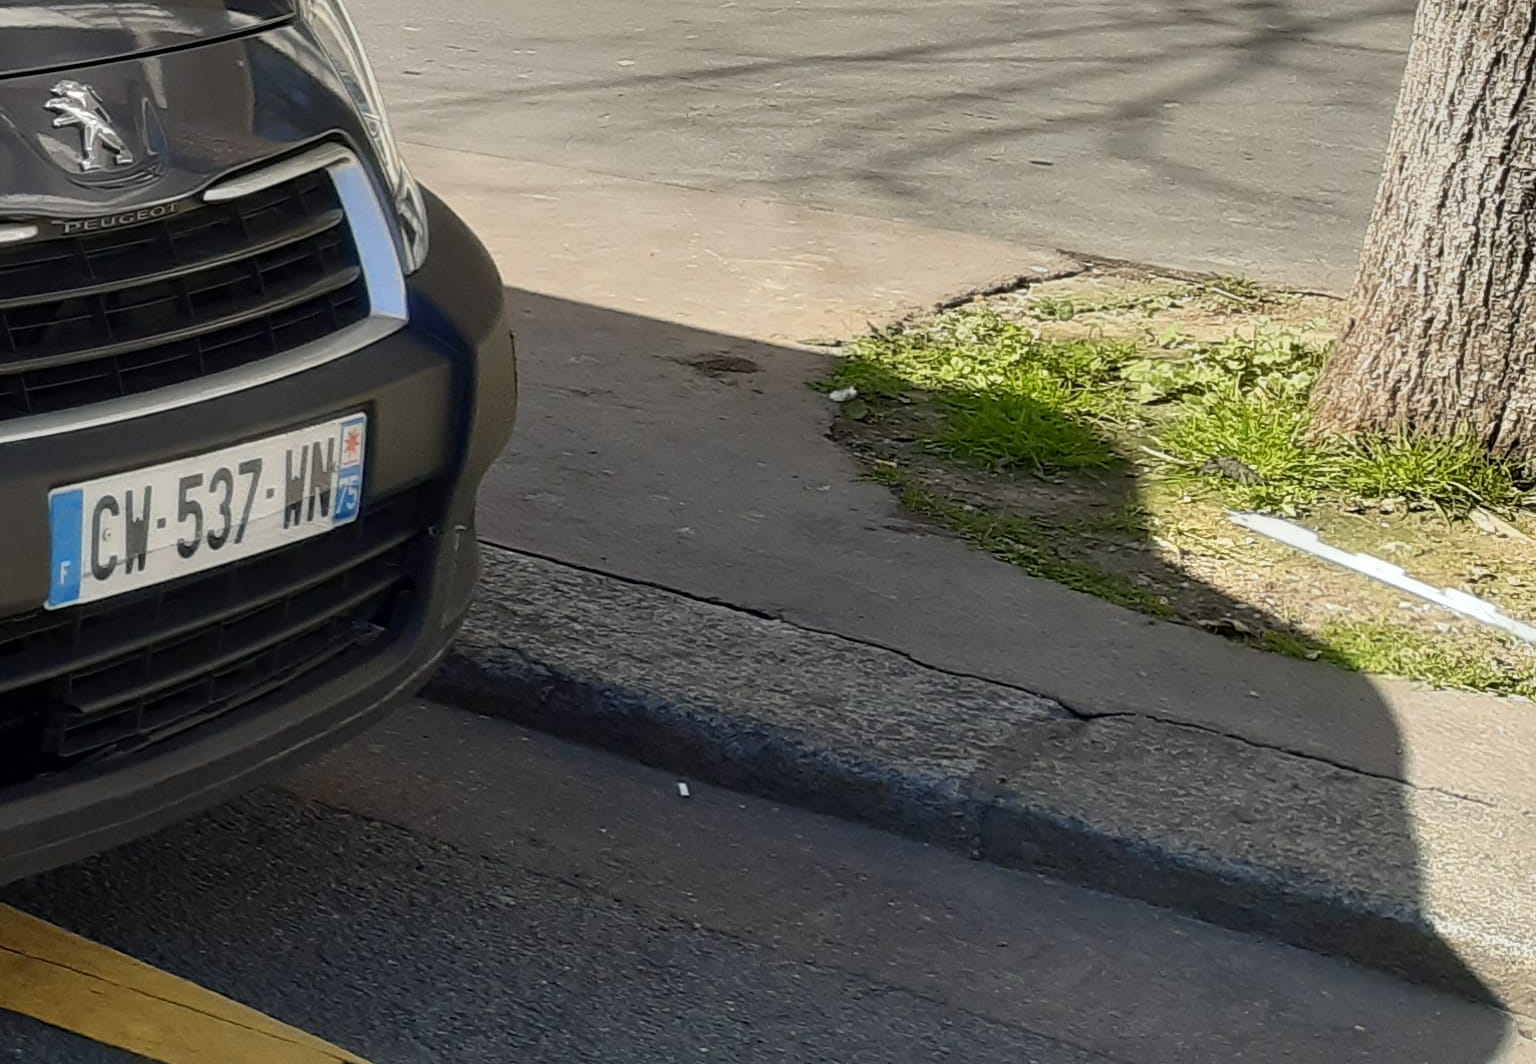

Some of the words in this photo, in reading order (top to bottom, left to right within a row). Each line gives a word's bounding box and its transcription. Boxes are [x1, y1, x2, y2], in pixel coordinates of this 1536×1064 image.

[64, 202, 177, 234] PEUGEOT
[90, 436, 336, 582] CW-537-WN
[335, 475, 360, 515] 75
[58, 561, 73, 586] F
